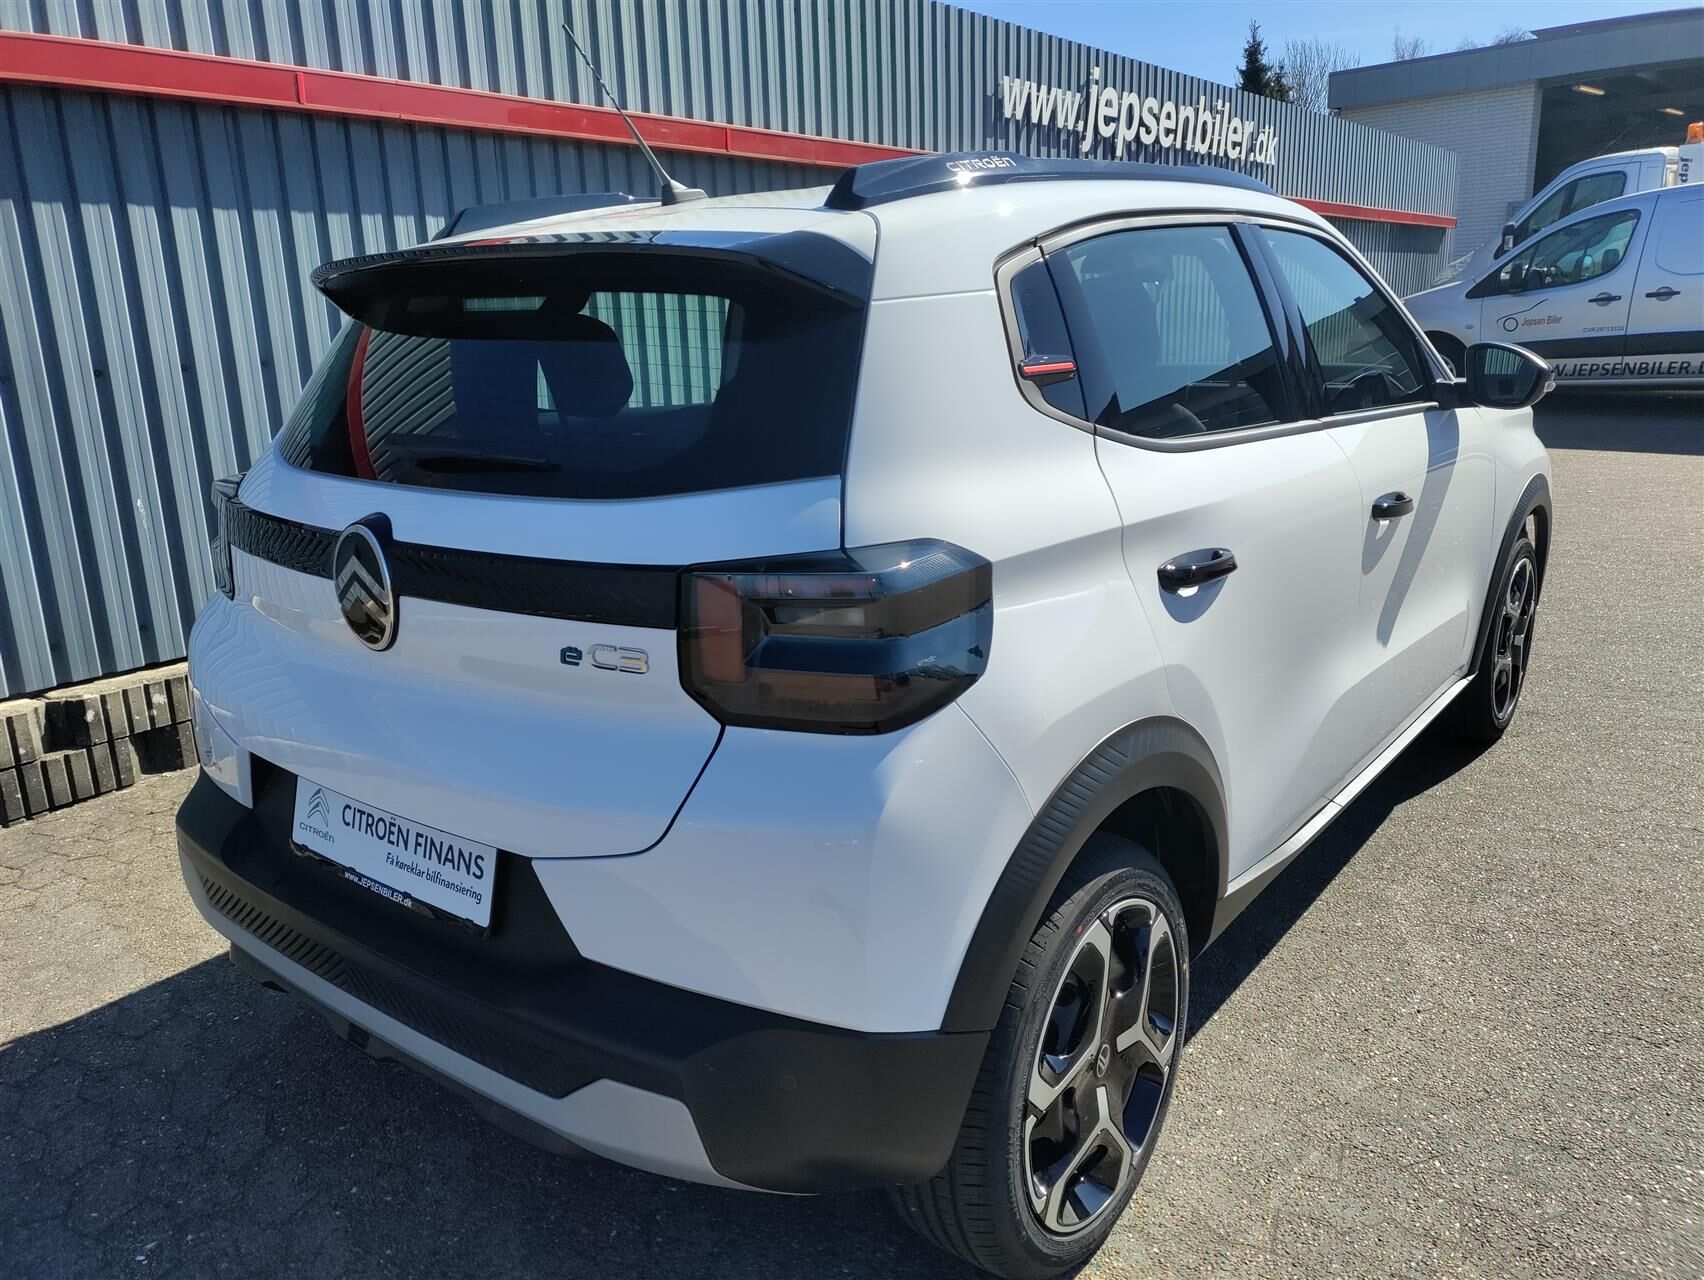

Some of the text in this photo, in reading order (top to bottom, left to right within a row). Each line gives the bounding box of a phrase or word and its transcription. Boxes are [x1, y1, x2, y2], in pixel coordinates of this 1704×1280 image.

[1002, 66, 1279, 165] www.jepsenbiler.dk
[1522, 315, 1562, 328] Jepsen Biler
[341, 804, 485, 880] CITROËN FINANS
[386, 852, 482, 905] Få køreklar bilfinansiering
